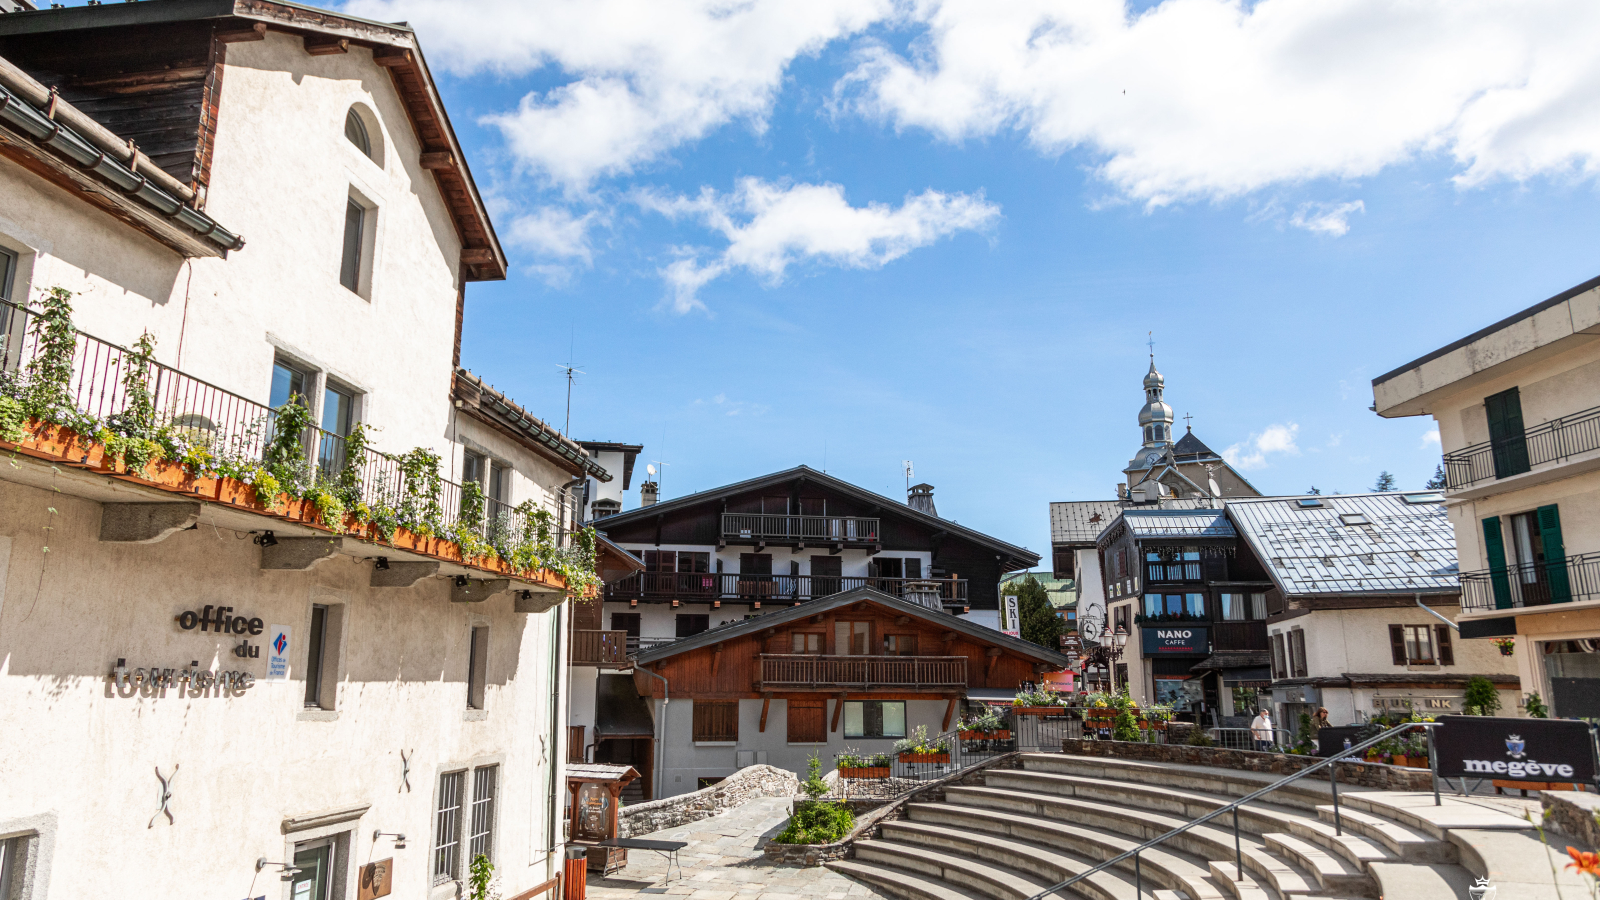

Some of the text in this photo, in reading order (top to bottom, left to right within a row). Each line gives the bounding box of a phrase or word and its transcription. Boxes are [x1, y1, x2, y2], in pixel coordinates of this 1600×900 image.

[179, 604, 264, 636] office
[1008, 598, 1017, 629] SKI
[1157, 630, 1193, 639] NANO
[235, 639, 260, 659] du
[113, 657, 255, 690] tourisme
[1462, 759, 1574, 778] megève
